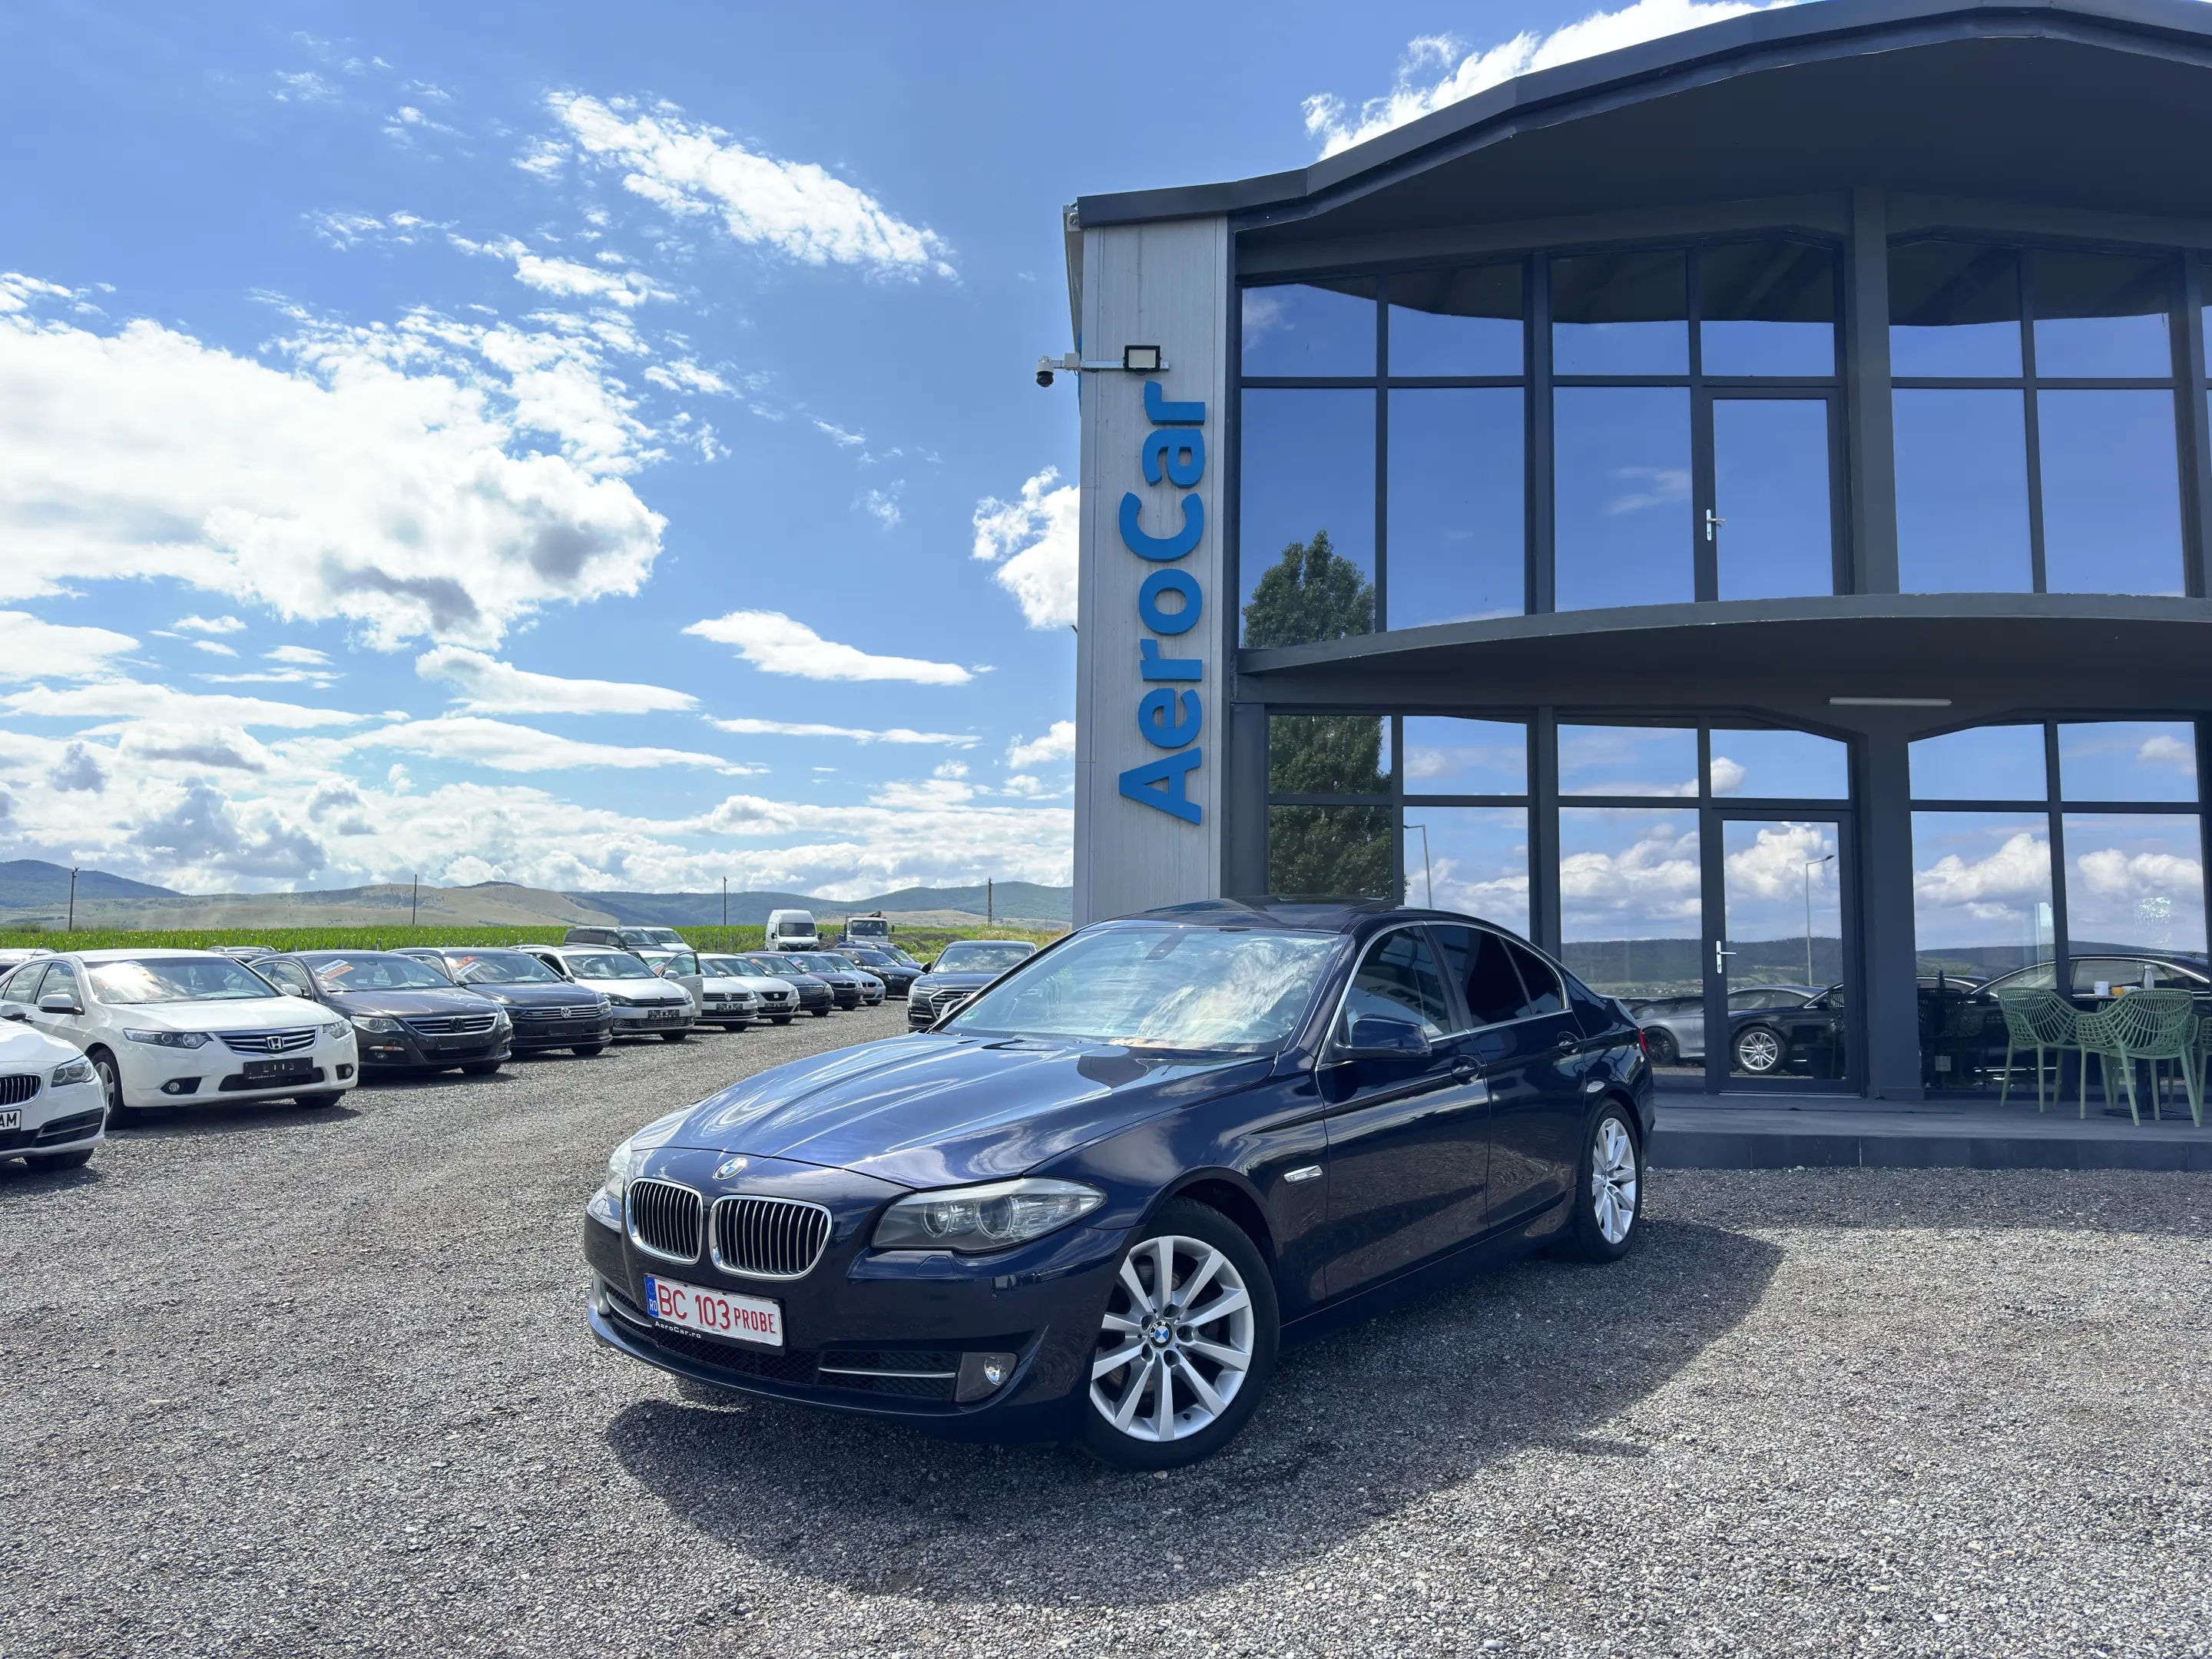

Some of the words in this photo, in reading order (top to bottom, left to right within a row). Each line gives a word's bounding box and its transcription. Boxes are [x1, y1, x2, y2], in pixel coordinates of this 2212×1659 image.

[1119, 380, 1207, 826] AeroCar
[649, 1298, 657, 1312] RO
[657, 1283, 687, 1320] BC
[695, 1294, 730, 1330] 103
[733, 1306, 776, 1334] PROBE
[655, 1320, 701, 1339] AeroCar.ro
